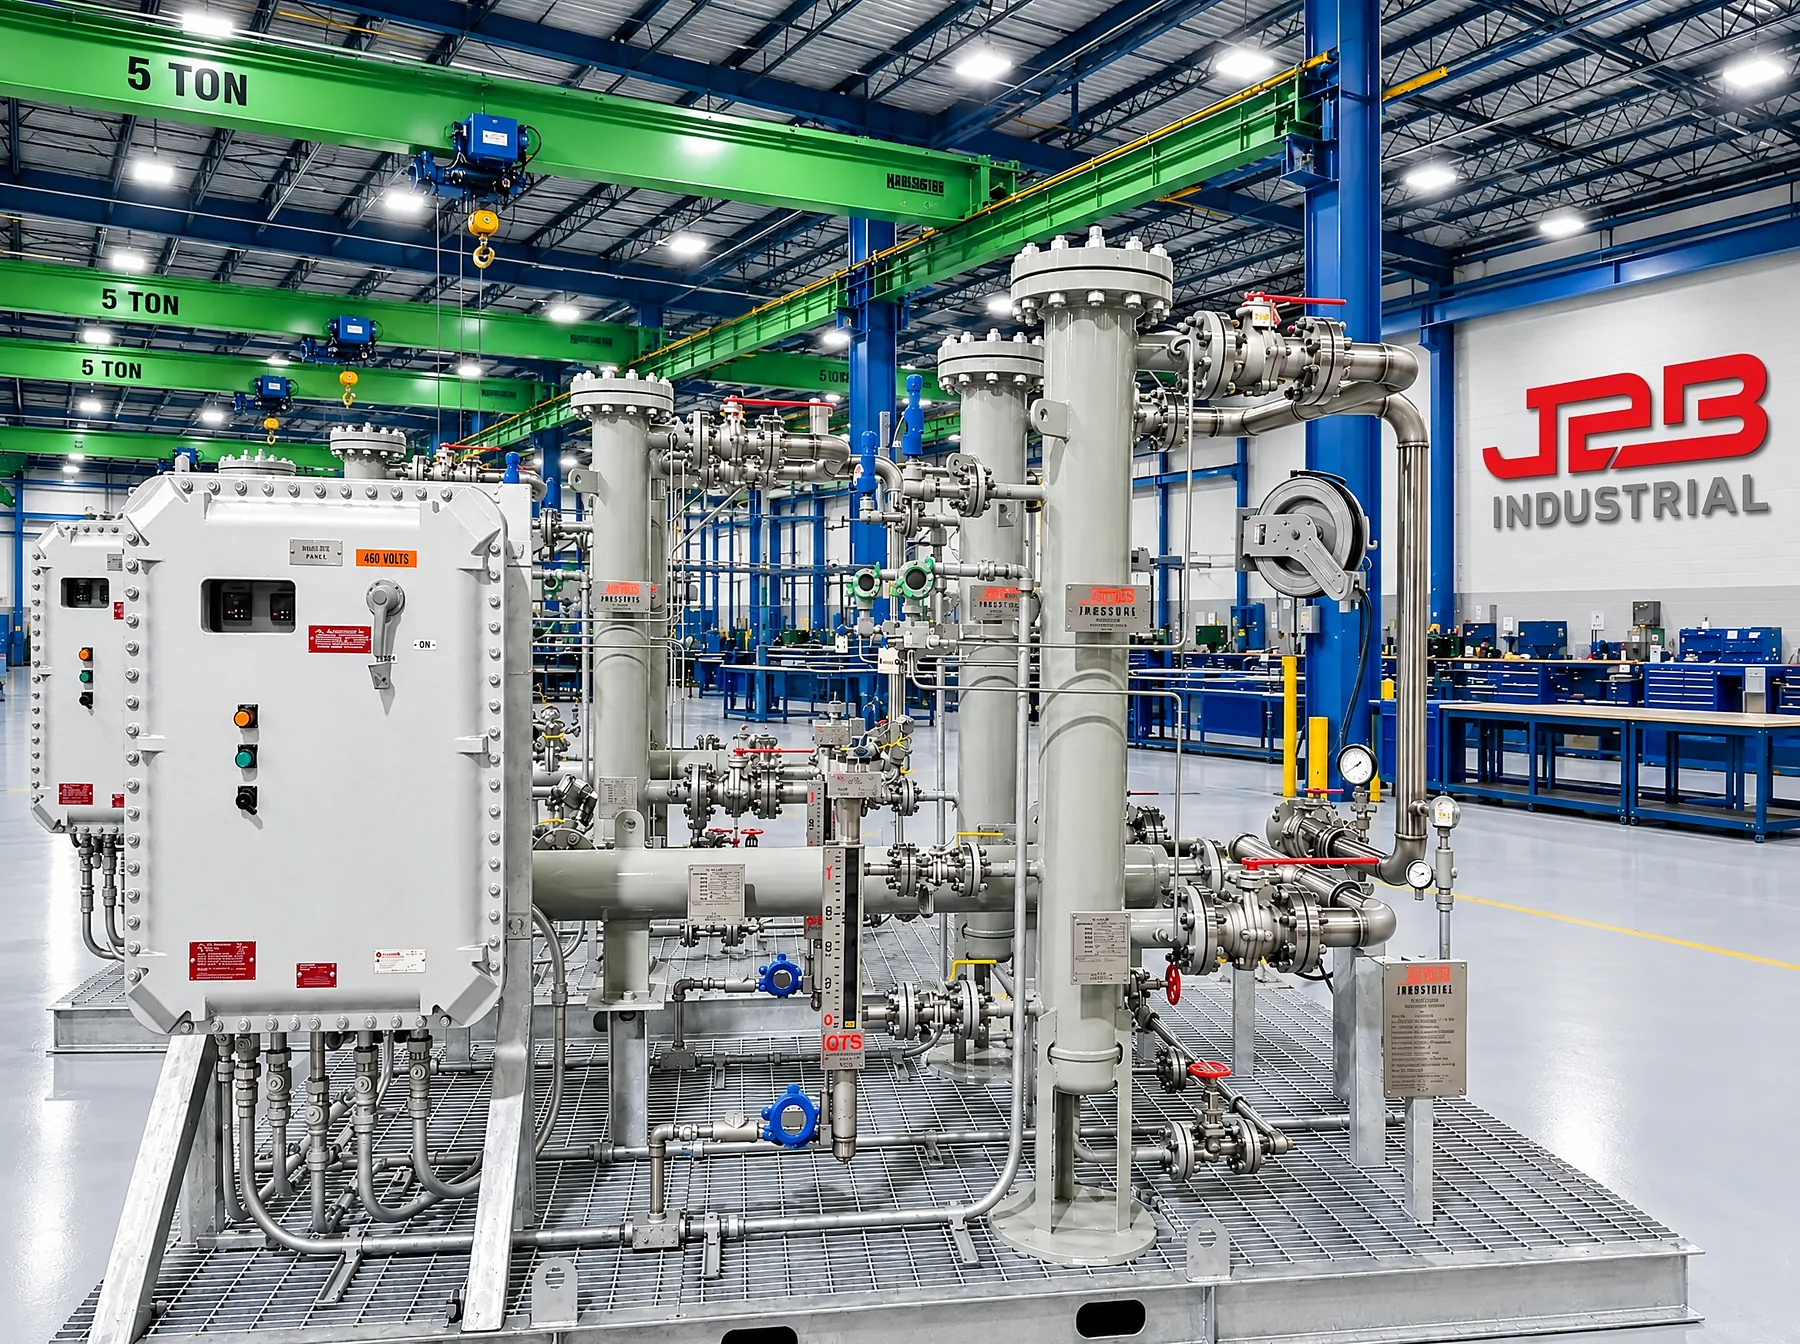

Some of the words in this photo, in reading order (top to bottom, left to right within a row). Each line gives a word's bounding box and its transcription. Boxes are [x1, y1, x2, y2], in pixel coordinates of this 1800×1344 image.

[128, 56, 151, 90] 5
[168, 62, 247, 106] TON
[102, 288, 117, 309] 5
[128, 291, 179, 315] TON
[82, 359, 93, 375] 5
[101, 360, 142, 379] TON
[1493, 474, 1768, 528] INDUSTRIAL
[364, 553, 380, 564] 460
[383, 553, 409, 564] VOLTS
